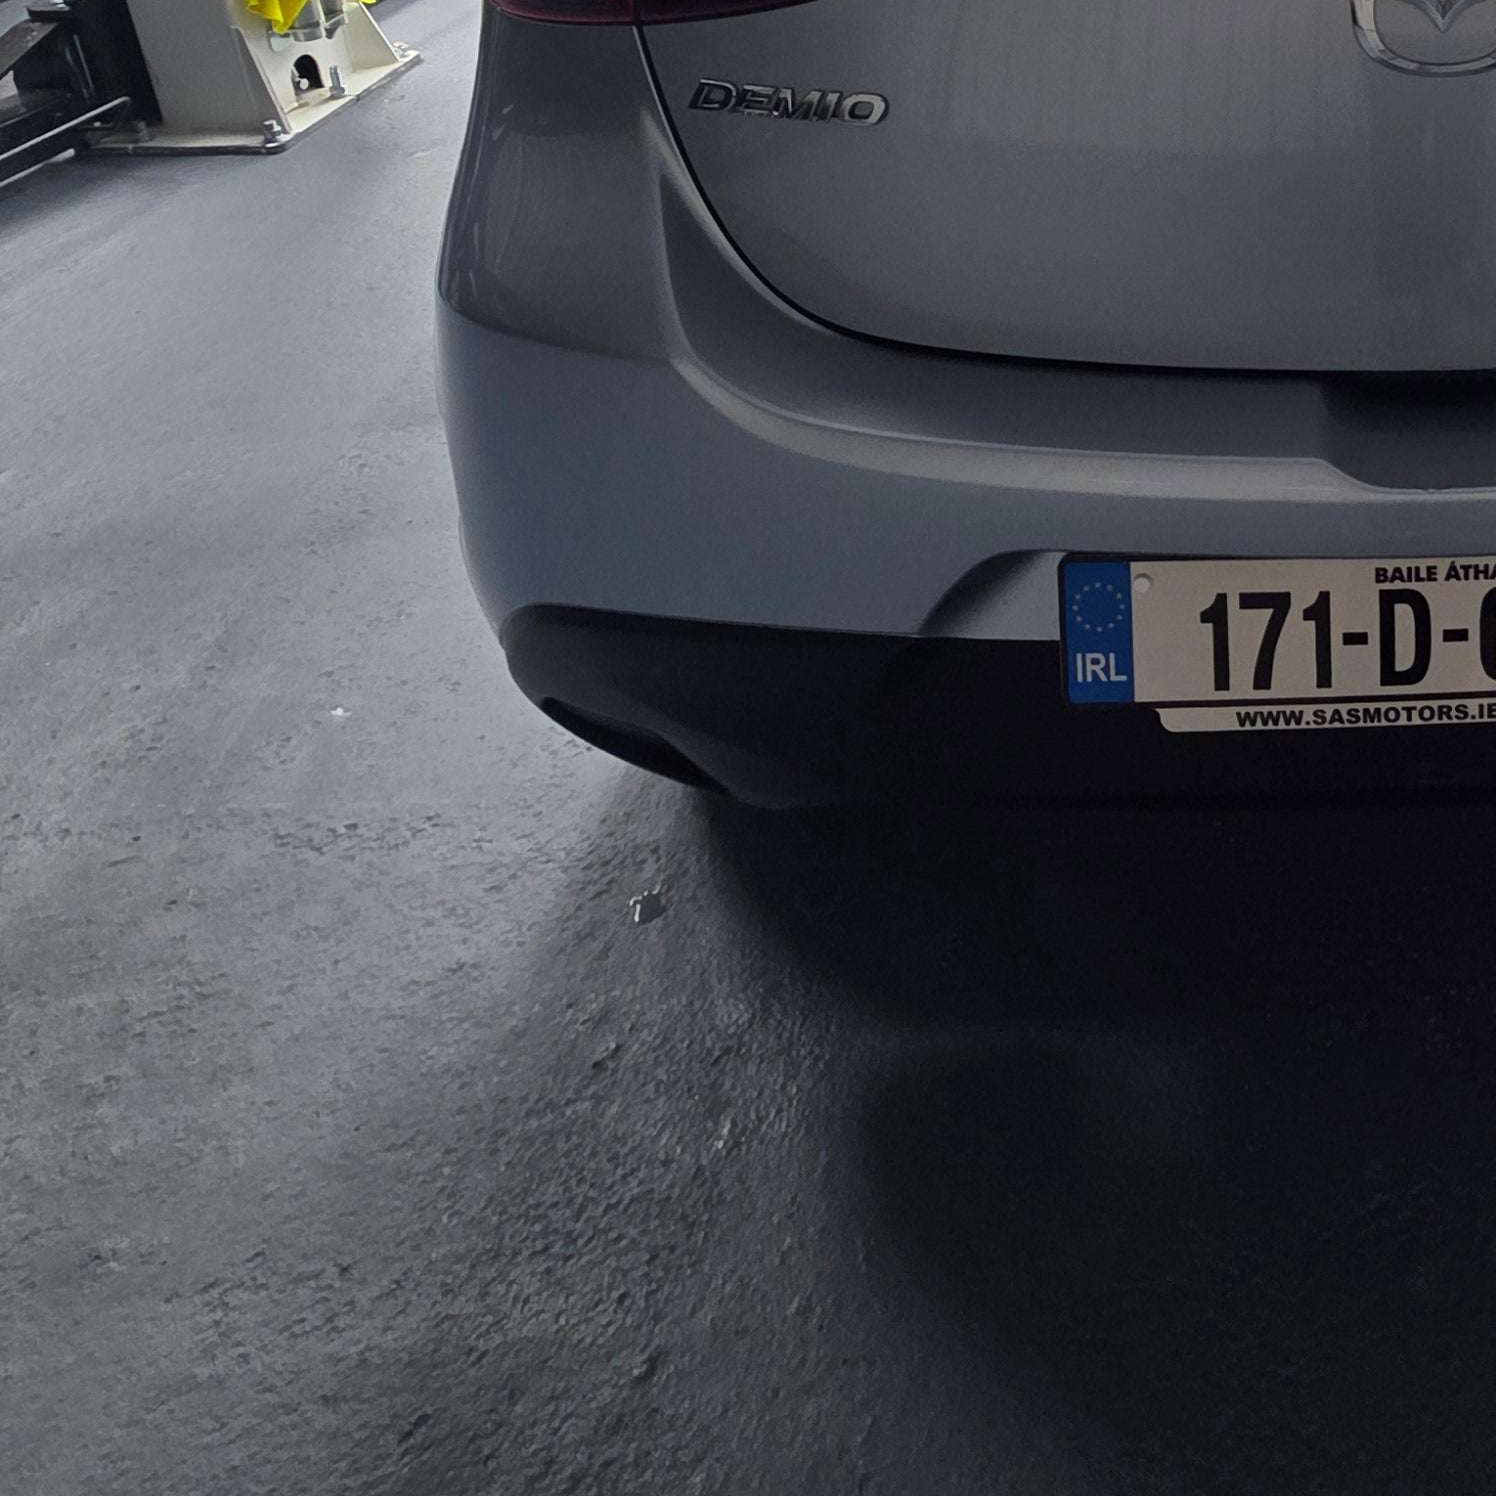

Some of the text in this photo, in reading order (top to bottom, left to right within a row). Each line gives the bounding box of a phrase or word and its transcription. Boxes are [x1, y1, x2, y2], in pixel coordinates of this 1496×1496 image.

[689, 78, 889, 125] DEMIO
[1375, 566, 1438, 584] BAILE
[1076, 653, 1128, 683] IRL
